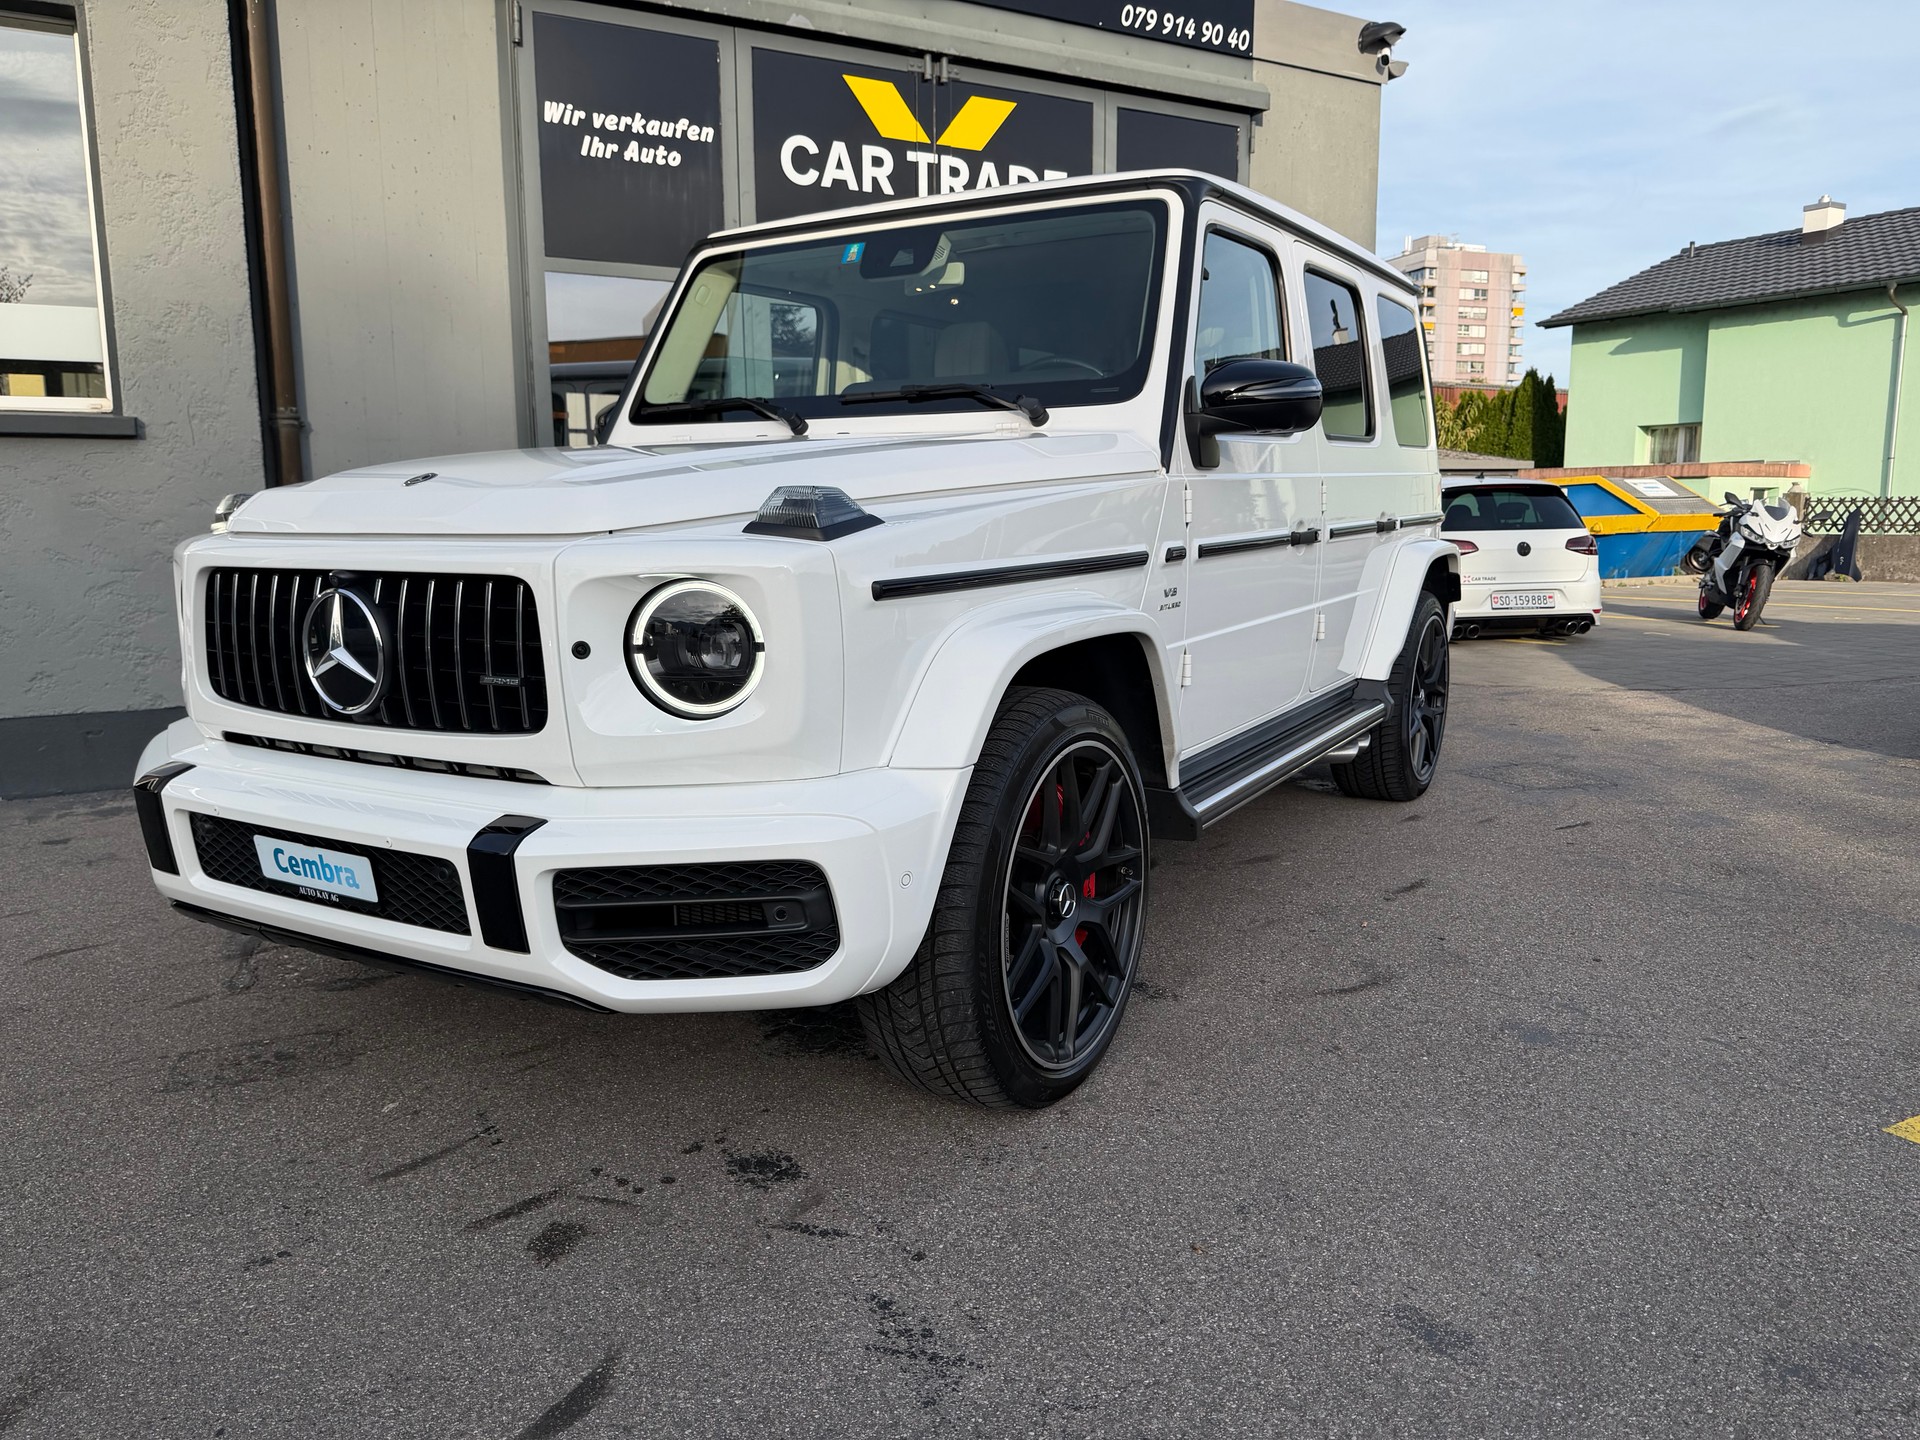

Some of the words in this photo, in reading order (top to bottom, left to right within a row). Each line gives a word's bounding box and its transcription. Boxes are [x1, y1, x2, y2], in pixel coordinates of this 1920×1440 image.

[1121, 4, 1158, 32] 079
[1162, 12, 1196, 40] 914
[1201, 21, 1224, 46] 90
[1227, 27, 1250, 51] 40
[544, 100, 586, 126] Wir
[592, 112, 715, 143] verkaufen
[580, 134, 619, 159] Ihr
[623, 140, 682, 167] Auto
[780, 134, 895, 196] CAR
[906, 150, 1068, 198] TRA
[1163, 587, 1178, 598] V8
[273, 847, 360, 890] Cembra
[299, 886, 316, 897] AUTO
[316, 890, 330, 900] KAY
[330, 893, 340, 902] AG
